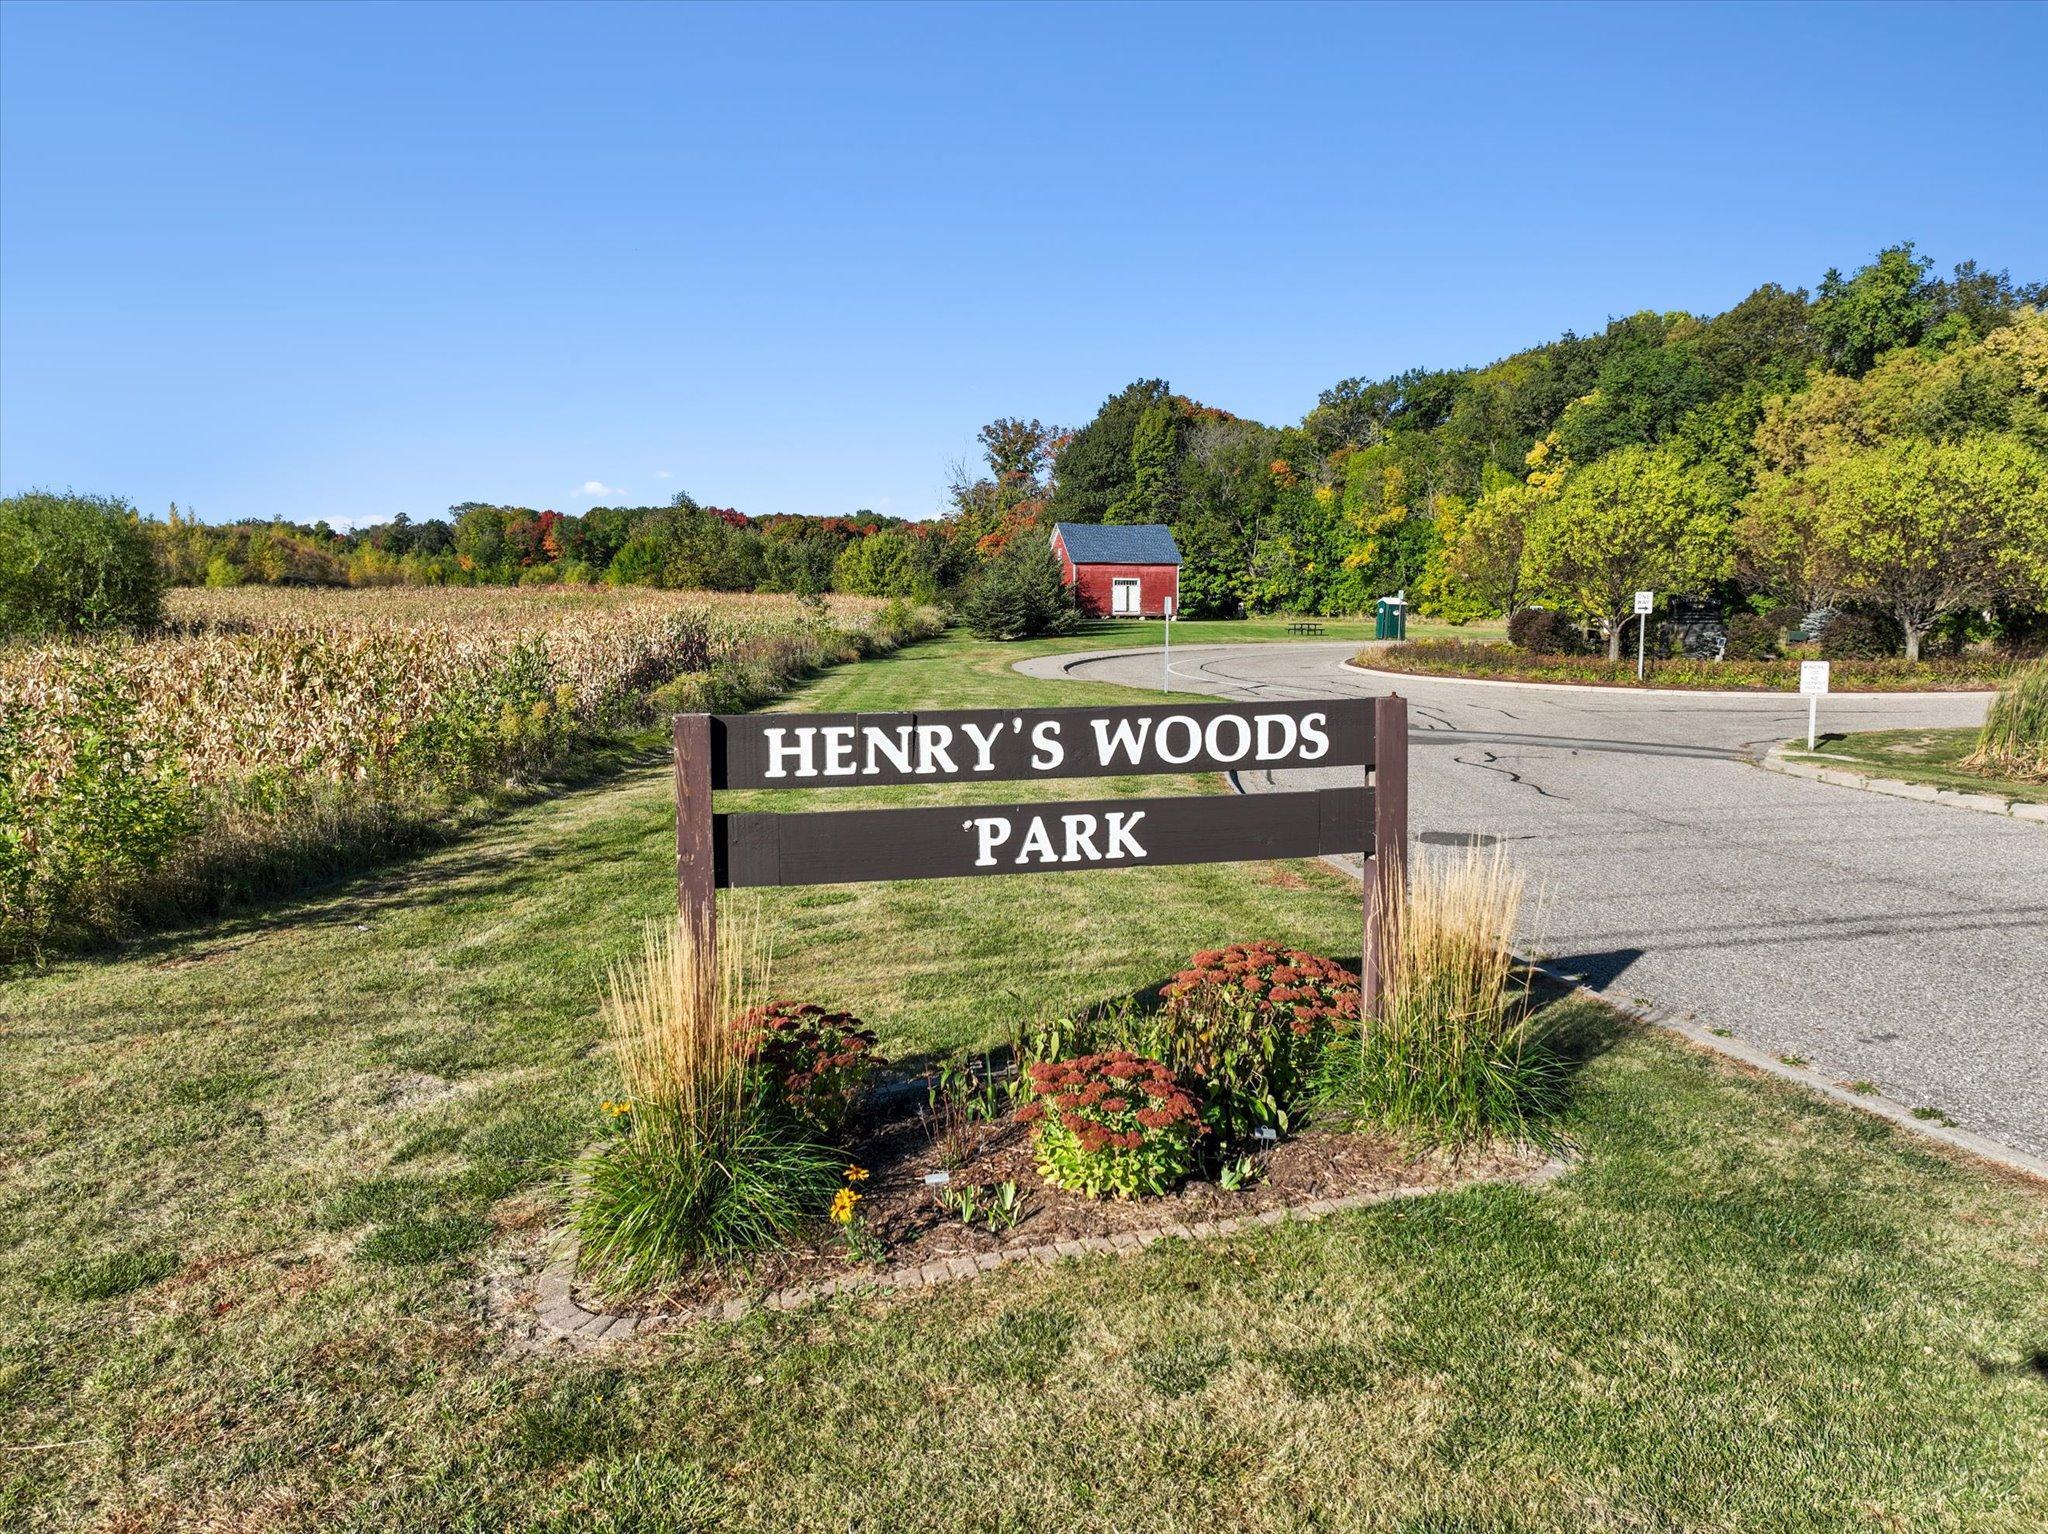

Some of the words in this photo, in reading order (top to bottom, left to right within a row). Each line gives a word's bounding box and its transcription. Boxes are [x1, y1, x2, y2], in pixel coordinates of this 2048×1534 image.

[763, 717, 1066, 778] HENRY'S
[1090, 712, 1331, 767] WOODS
[973, 810, 1148, 867] PARK
